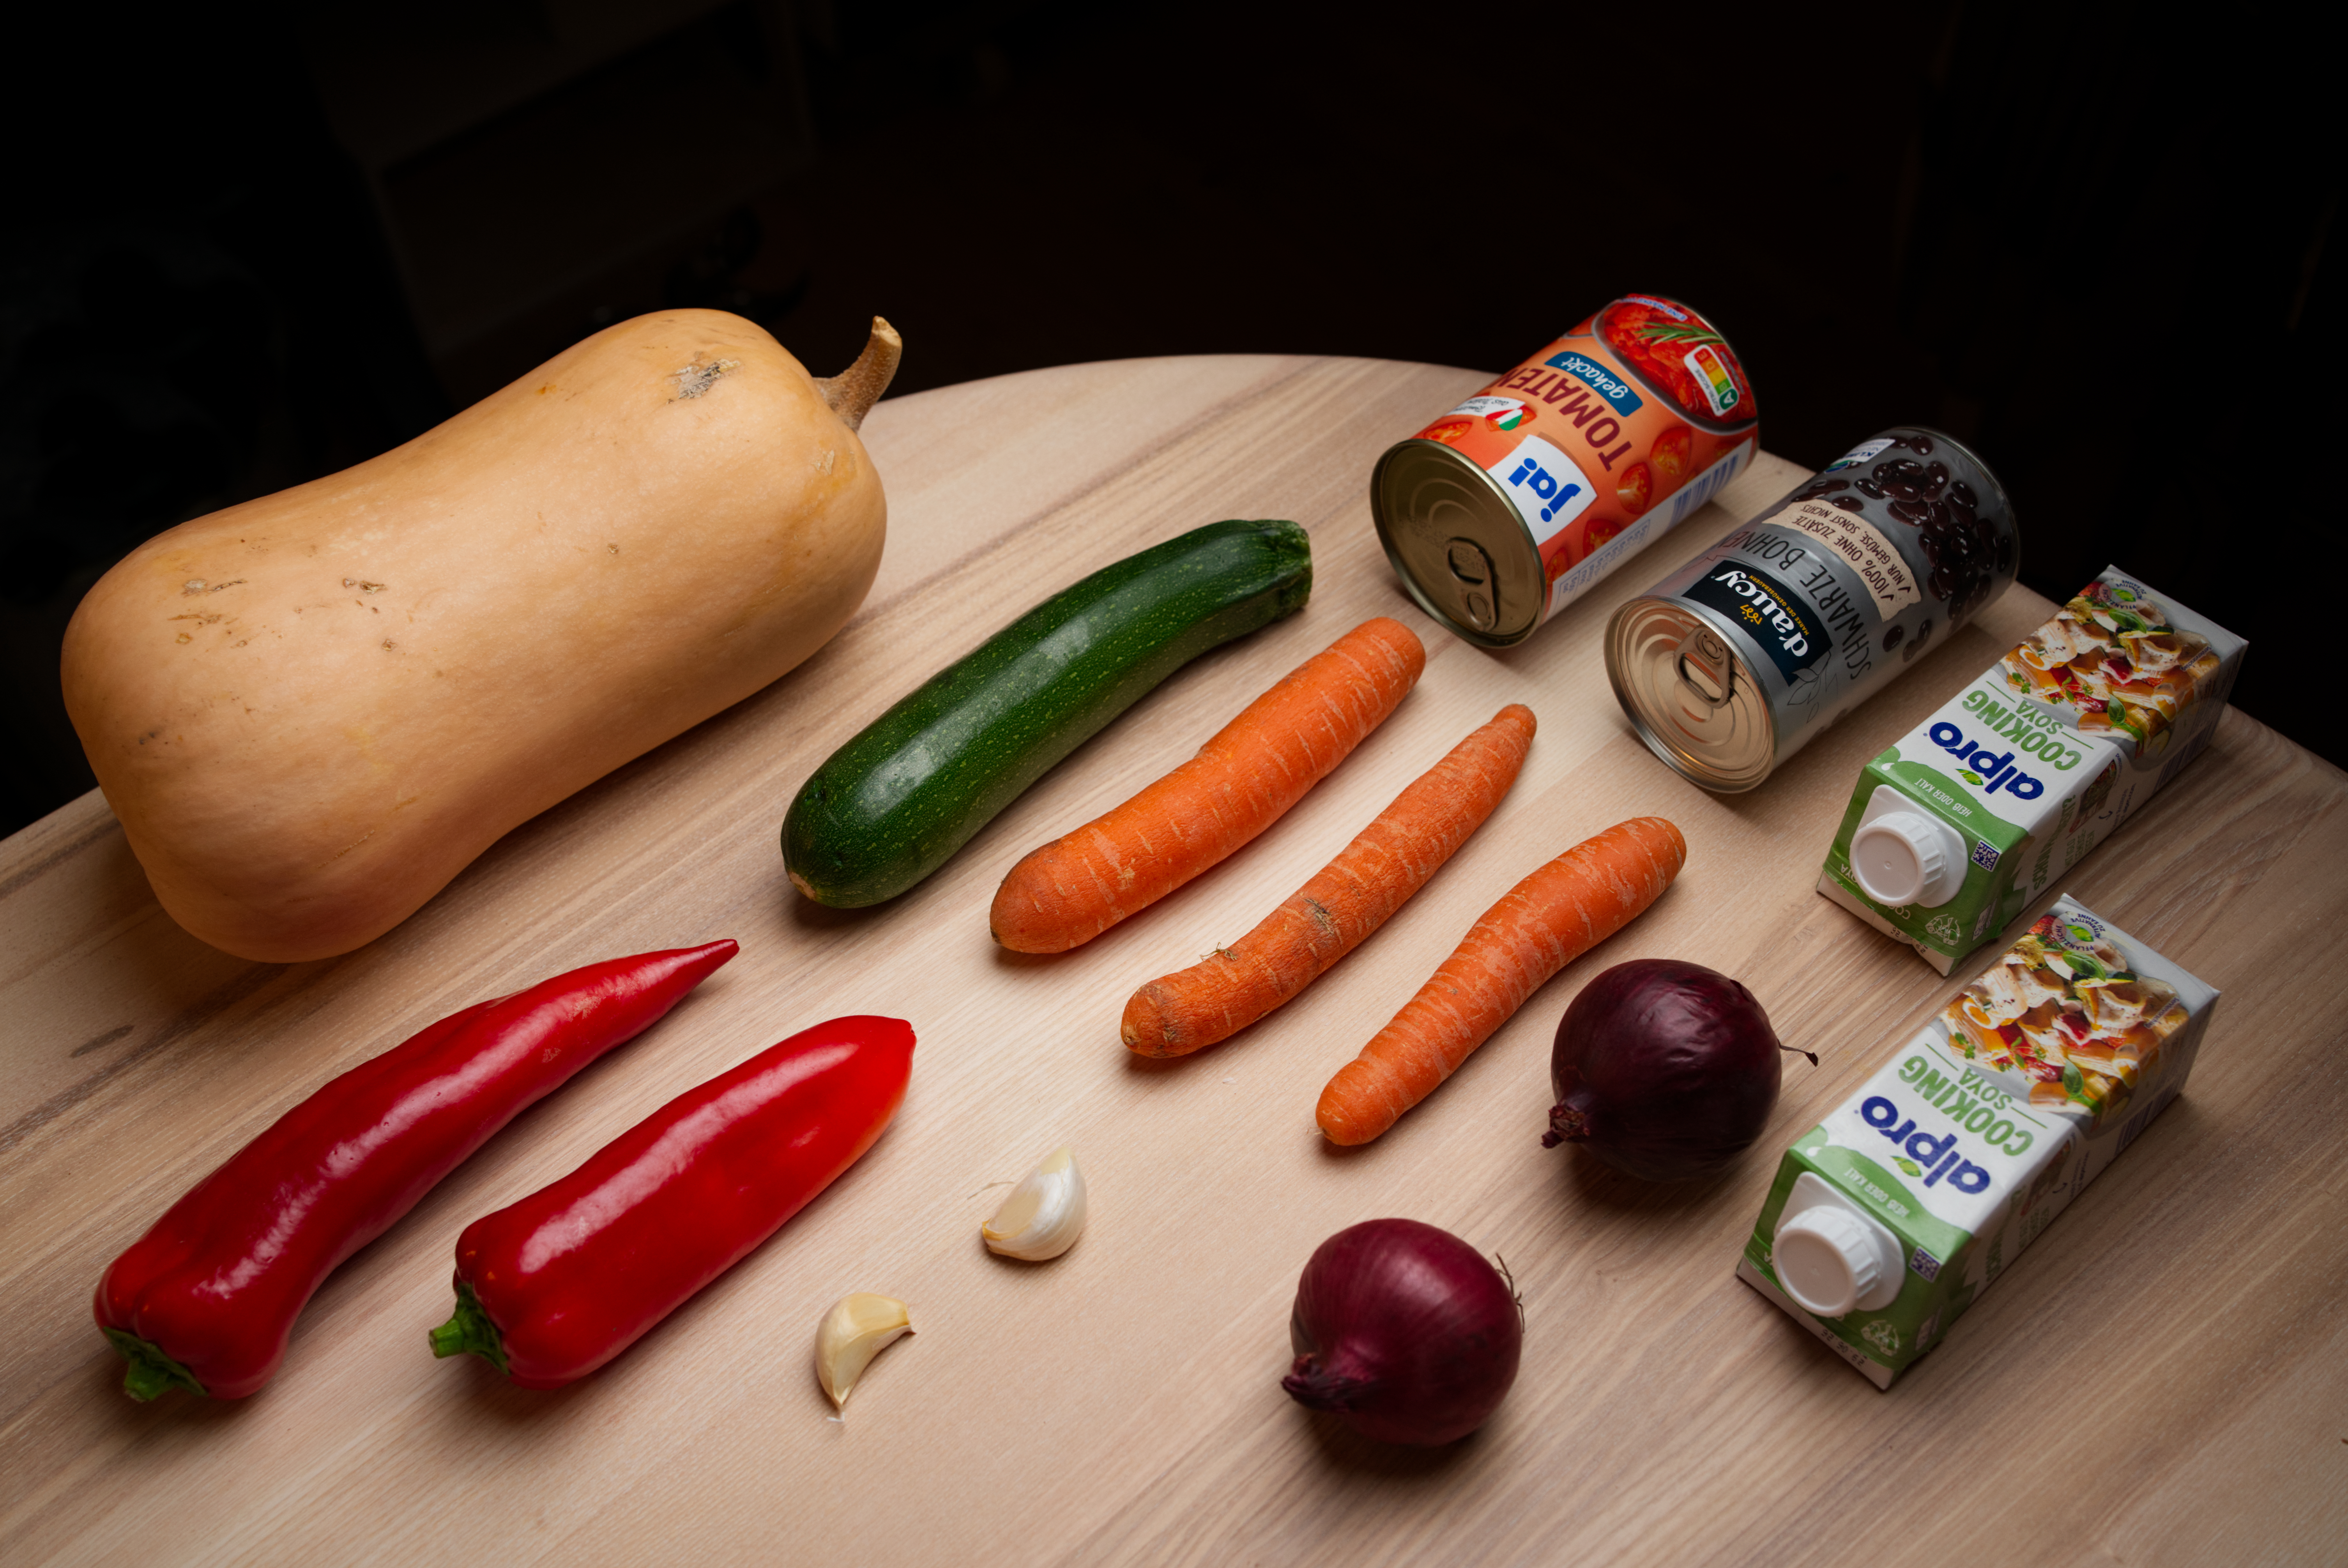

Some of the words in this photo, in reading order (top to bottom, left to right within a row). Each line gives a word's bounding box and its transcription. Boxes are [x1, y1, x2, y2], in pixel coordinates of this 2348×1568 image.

[1697, 351, 1708, 360] E
[1706, 361, 1715, 371] D
[1560, 357, 1628, 399] gehackt
[1724, 391, 1734, 404] A
[1508, 457, 1581, 522] ja!
[1800, 504, 1833, 518] NICHTS
[1792, 516, 1836, 539] ZUSÄTZE
[1830, 515, 1860, 534] SONST
[1833, 535, 1863, 561] OHNE
[1860, 531, 1890, 564] GEMÜSE,
[1862, 560, 1890, 594] 100%
[1887, 564, 1905, 585] NUR
[1749, 575, 1787, 606] GEMÜSEBAUERN
[2102, 589, 2136, 609] PFLANZLICHE
[1715, 570, 1808, 657] d'aucy
[1786, 606, 1796, 617] DER
[1799, 564, 1872, 680] SCHWARZE
[1794, 616, 1809, 636] MARKE
[2016, 700, 2063, 735] SOYA
[1962, 690, 2082, 770] COOKING
[1929, 722, 2044, 800] alpro
[1914, 778, 1935, 793] KALT
[1933, 790, 1954, 805] ODER
[1841, 863, 1857, 883] OYA
[2070, 918, 2100, 939] ALTERNATIVE
[2077, 913, 2099, 925] SAHNE
[2056, 925, 2094, 951] PFLANZLICHE
[1958, 1067, 2013, 1110] SOYA
[1898, 1055, 2033, 1156] COOKING
[1861, 1095, 1990, 1194] alpro
[1843, 1167, 1868, 1187] KALT
[1864, 1183, 1889, 1203] ODER
